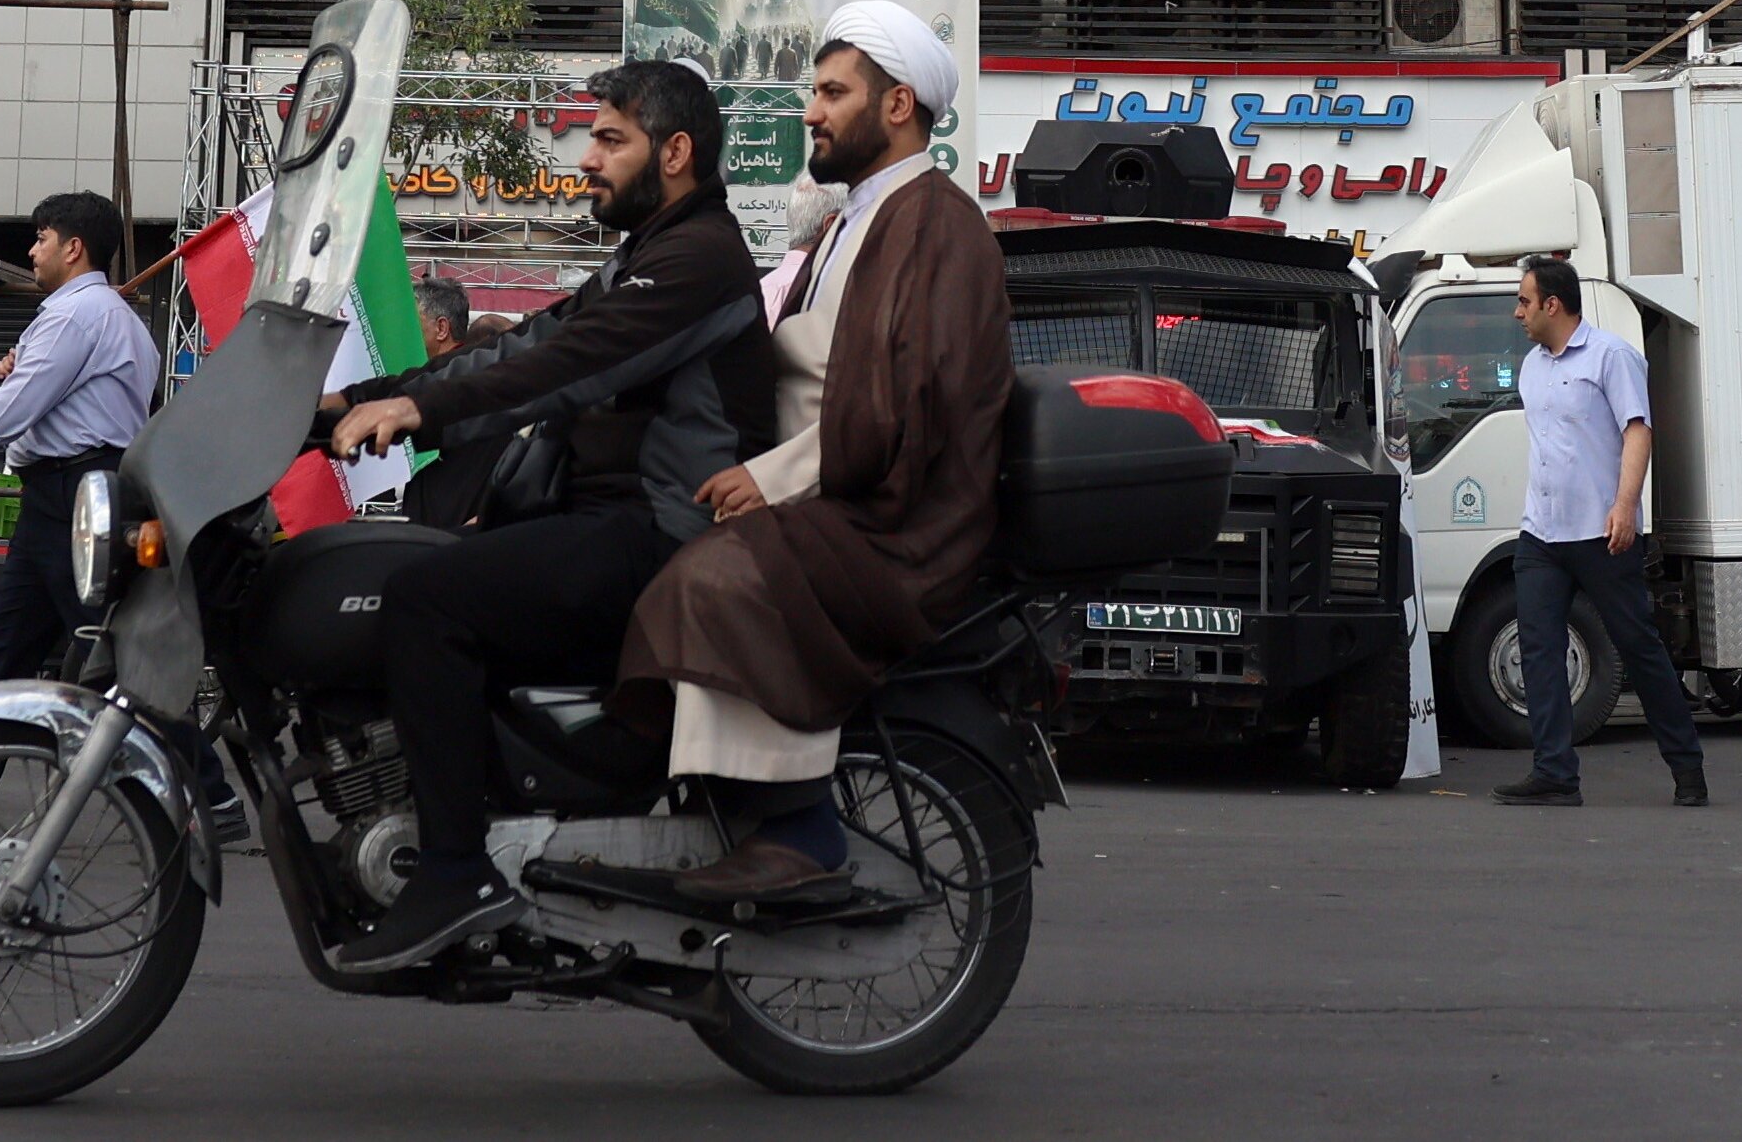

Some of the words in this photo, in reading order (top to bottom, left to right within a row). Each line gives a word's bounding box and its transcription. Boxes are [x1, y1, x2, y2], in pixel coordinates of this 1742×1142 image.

[1230, 76, 1415, 147] مجتمع
[727, 130, 777, 146] استاد
[727, 151, 783, 175] پناهیان
[1330, 156, 1448, 201] راحی
[737, 199, 787, 214] دارالحکمه
